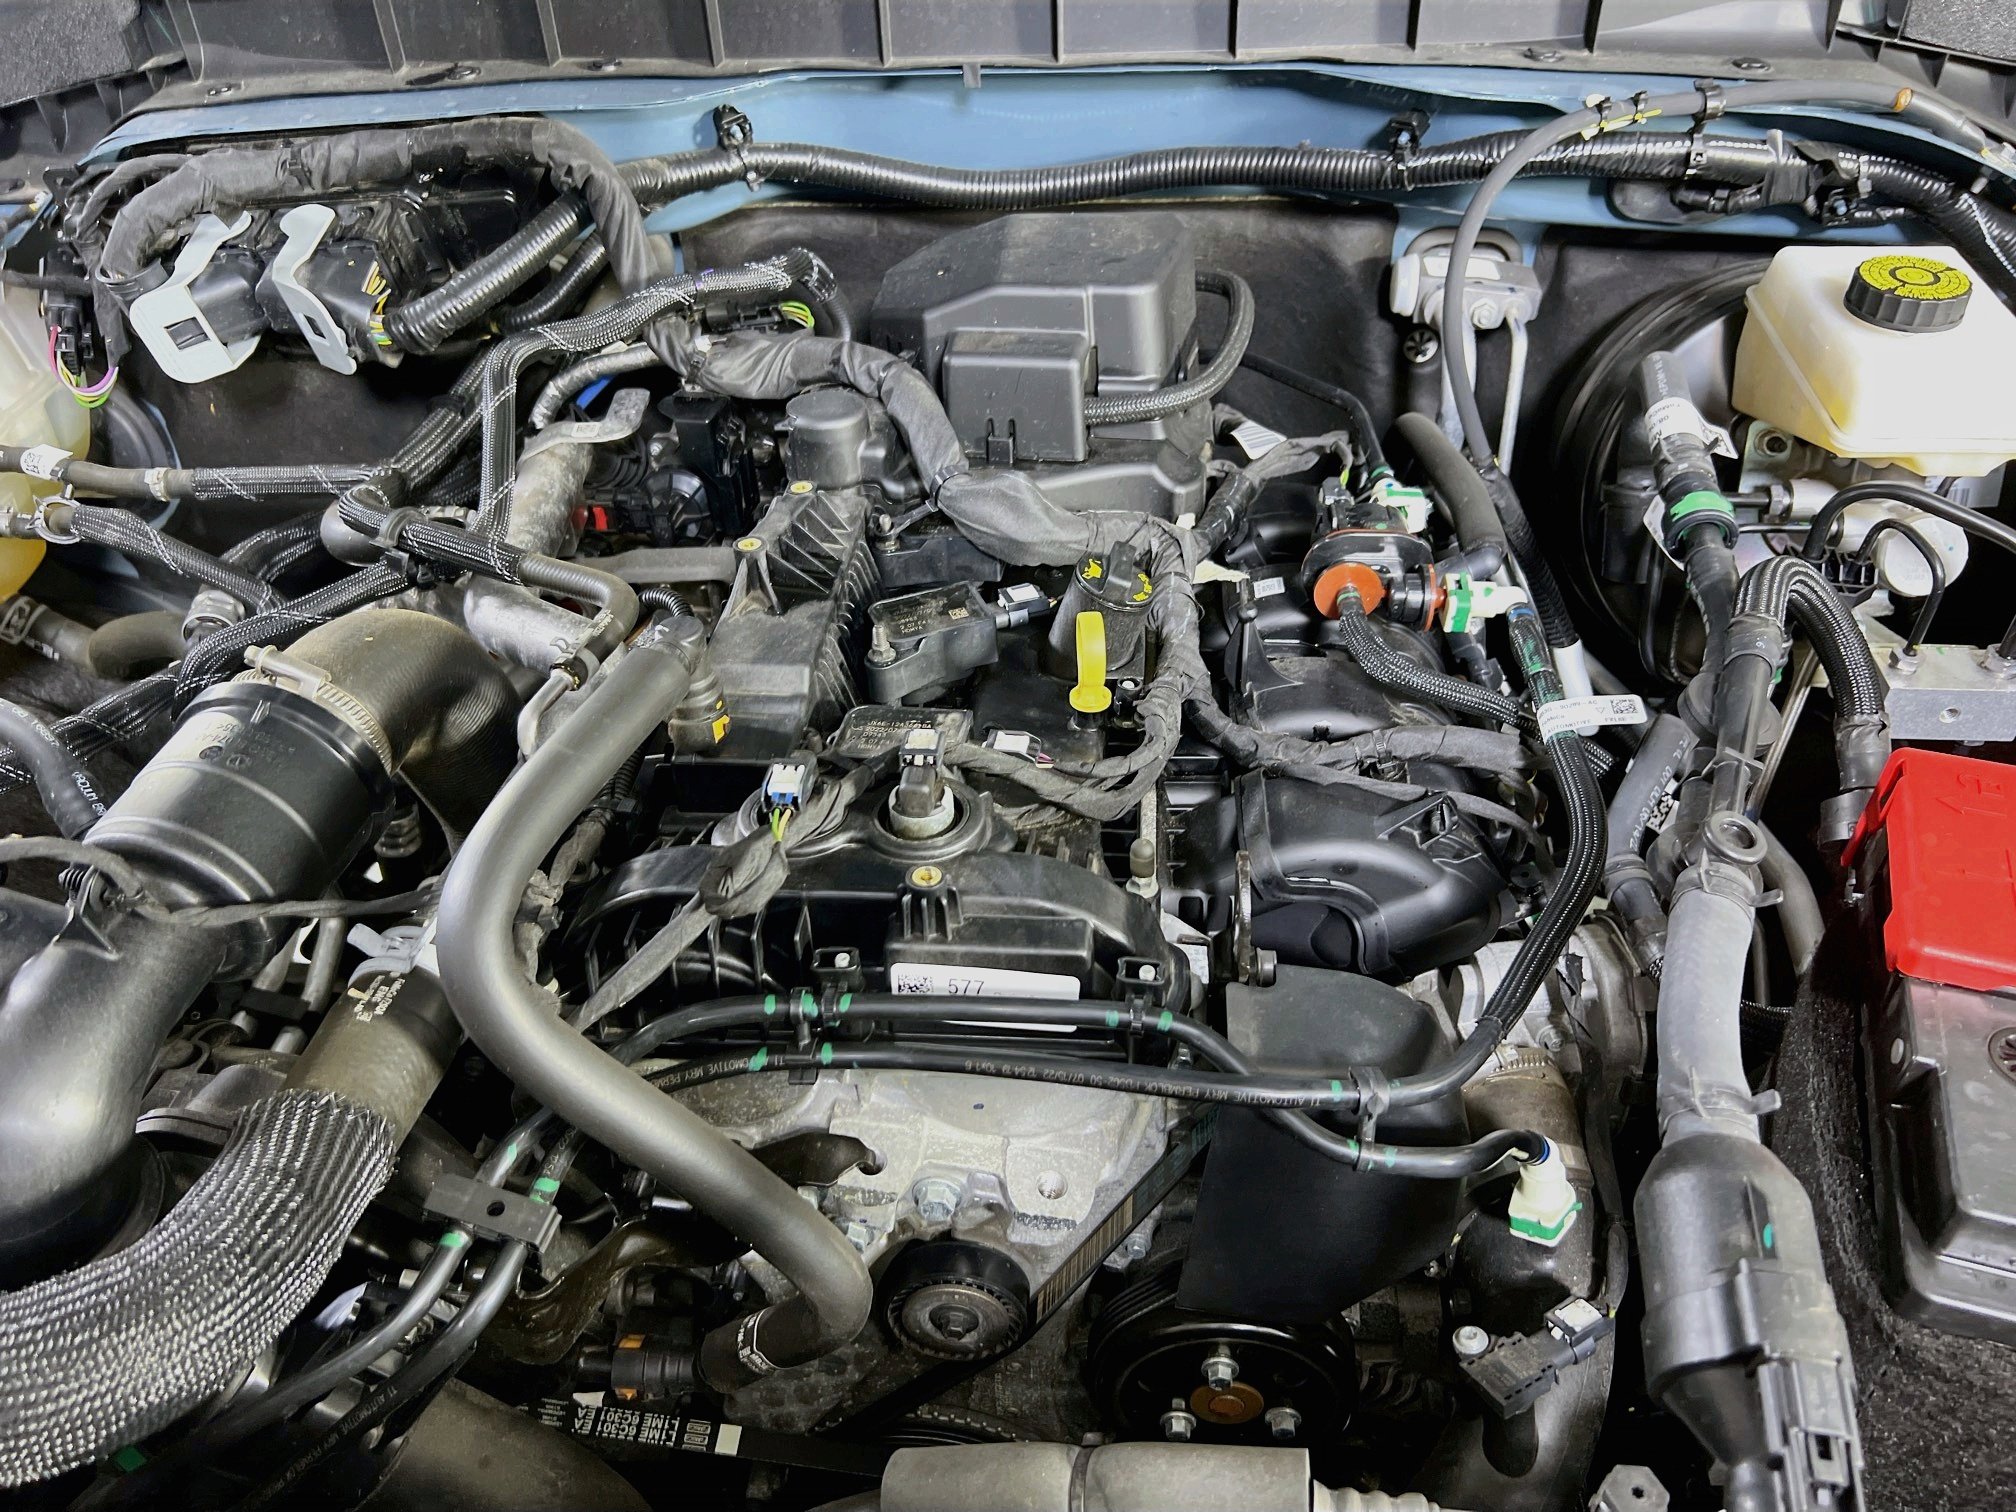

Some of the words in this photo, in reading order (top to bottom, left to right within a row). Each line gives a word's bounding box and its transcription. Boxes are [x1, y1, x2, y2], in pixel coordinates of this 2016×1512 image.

[947, 978, 985, 995] 577
[1233, 1088, 1306, 1108] AUTOMOTIVE
[574, 1417, 593, 1433] EA
[600, 1411, 640, 1426] 6C301
[598, 1422, 637, 1440] 6C301
